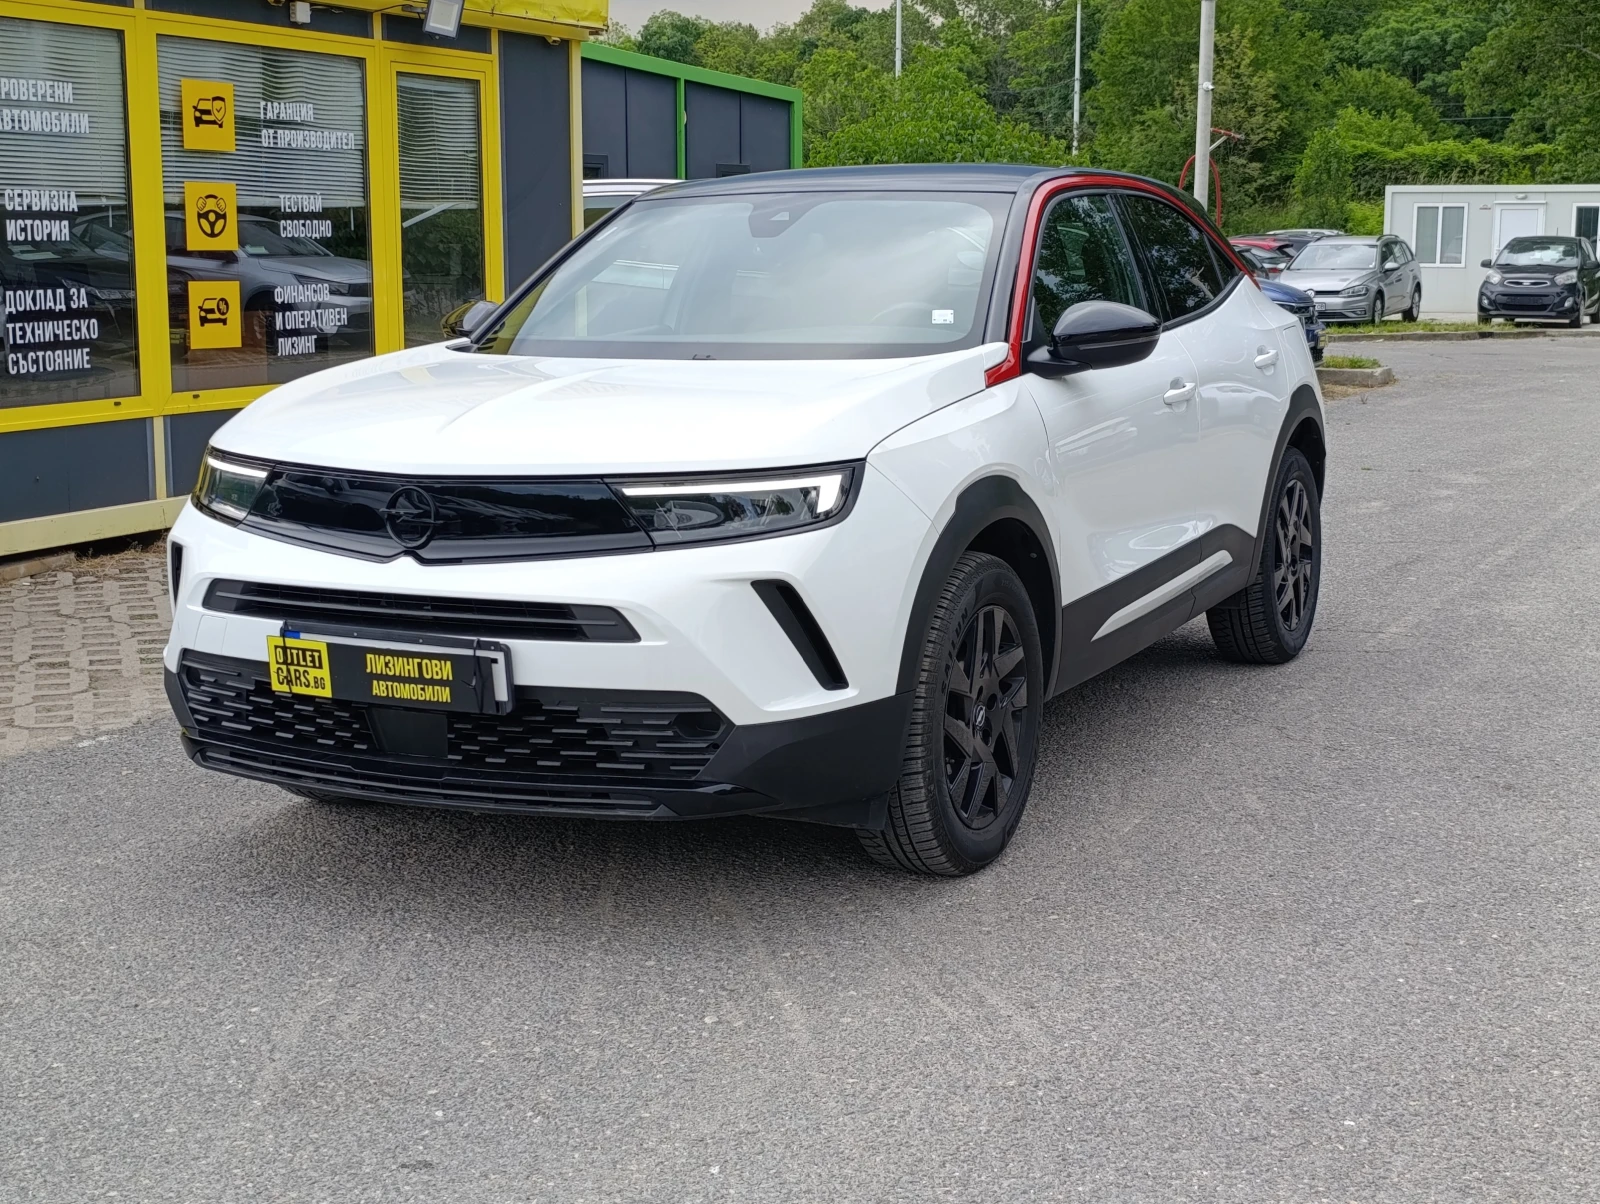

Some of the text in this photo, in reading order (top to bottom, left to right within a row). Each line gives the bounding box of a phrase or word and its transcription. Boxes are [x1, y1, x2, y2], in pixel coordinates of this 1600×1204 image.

[0, 78, 74, 103] РОВЕРЕНИ
[260, 101, 314, 122] ГАРАНЦИЯ
[261, 129, 355, 150] ОТ ПРОИЗВОДИТЕЛ
[4, 189, 78, 212] СЕРВИЗНА
[279, 192, 322, 213] ТЕСТВАЙ
[6, 219, 70, 242] ИСТОРИЯ
[280, 219, 332, 239] СВОБОДНО
[5, 287, 89, 315] ДОКЛАД ЗА
[274, 283, 330, 304] ФИНАНСОВ
[275, 307, 348, 331] И ОПЕРАТИВЕН
[6, 318, 99, 345] ТЕХНИЧЕСКО
[277, 335, 318, 356] ЛИЗИНГ
[8, 348, 91, 375] СЪСТОЯНИЕ
[276, 666, 326, 691] CARS.BG
[365, 654, 453, 680] ЛИЗИНГОВИ
[372, 680, 451, 702] АВТОМОБИЛИ
